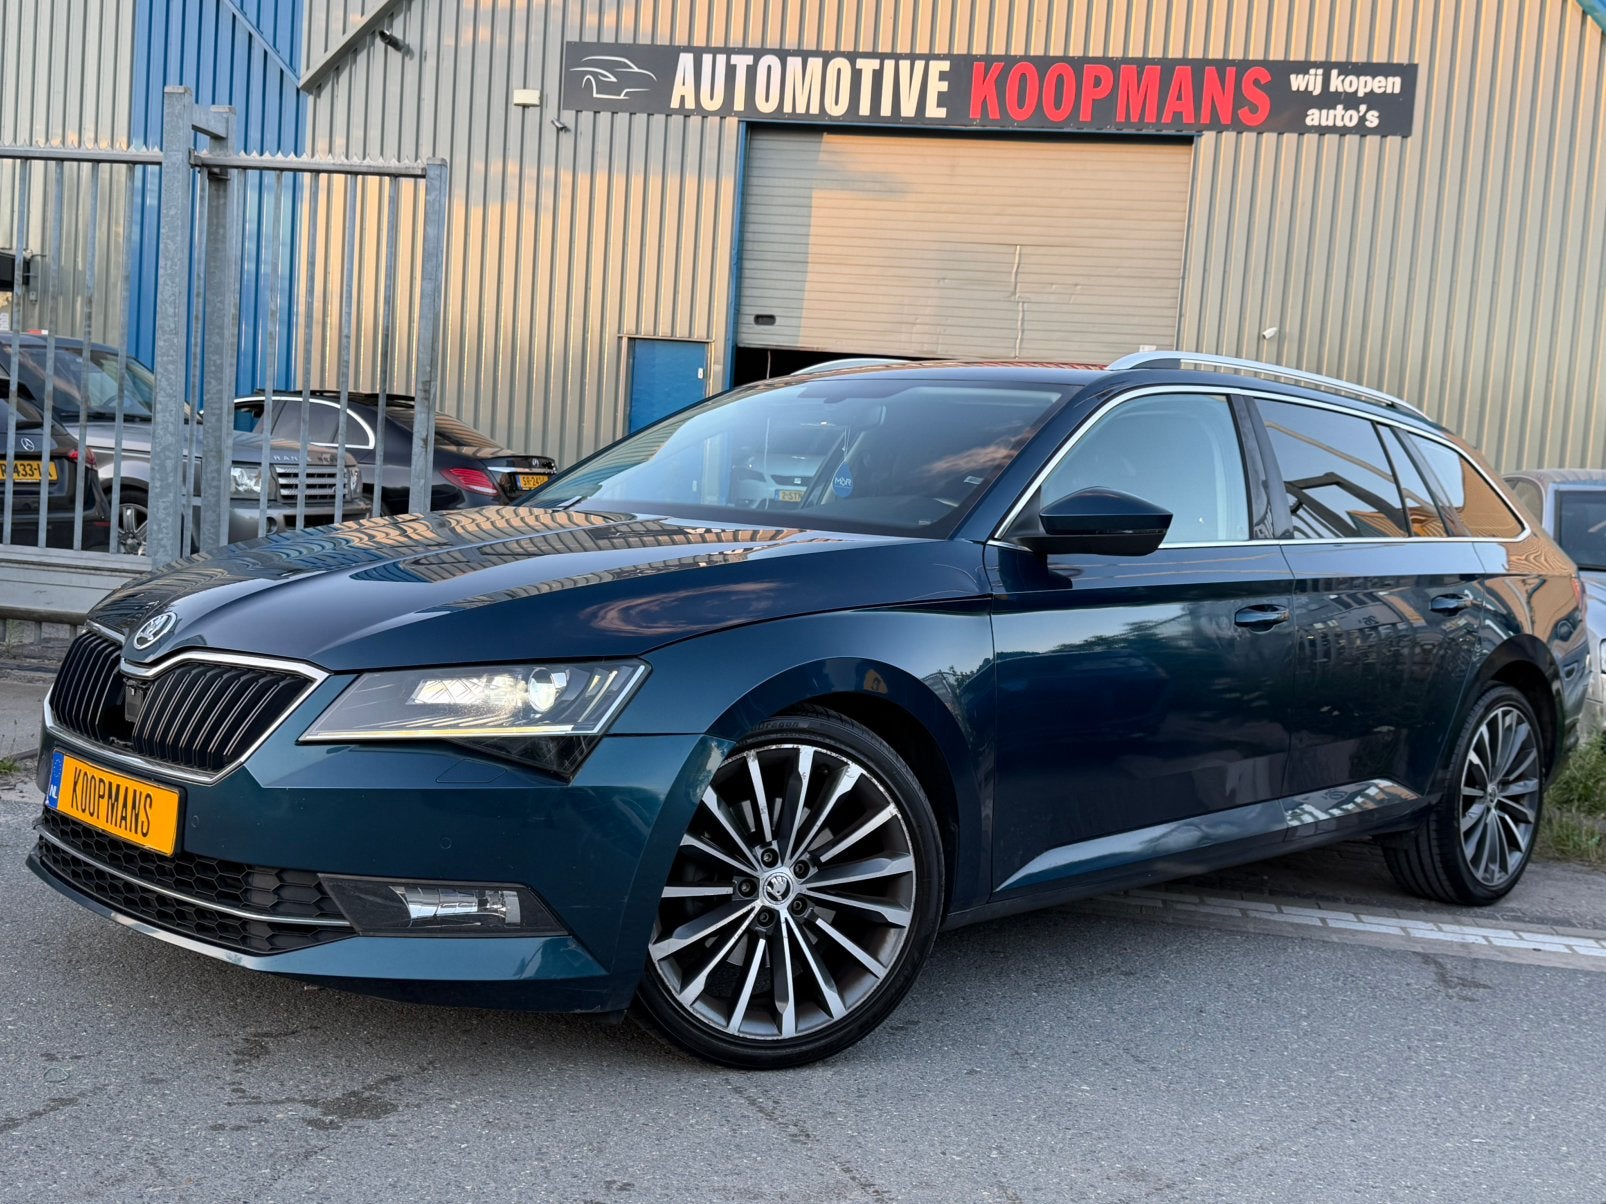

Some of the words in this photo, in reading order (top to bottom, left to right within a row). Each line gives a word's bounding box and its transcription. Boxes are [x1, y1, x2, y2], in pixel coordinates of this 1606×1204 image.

[669, 52, 951, 119] AUTOMOTIVE
[969, 61, 1272, 126] KOOPMANS
[1290, 68, 1323, 95] wij
[1329, 69, 1402, 97] kopen
[1305, 104, 1379, 127] auto's
[49, 784, 58, 799] NL
[71, 766, 153, 838] KOOPMANS
